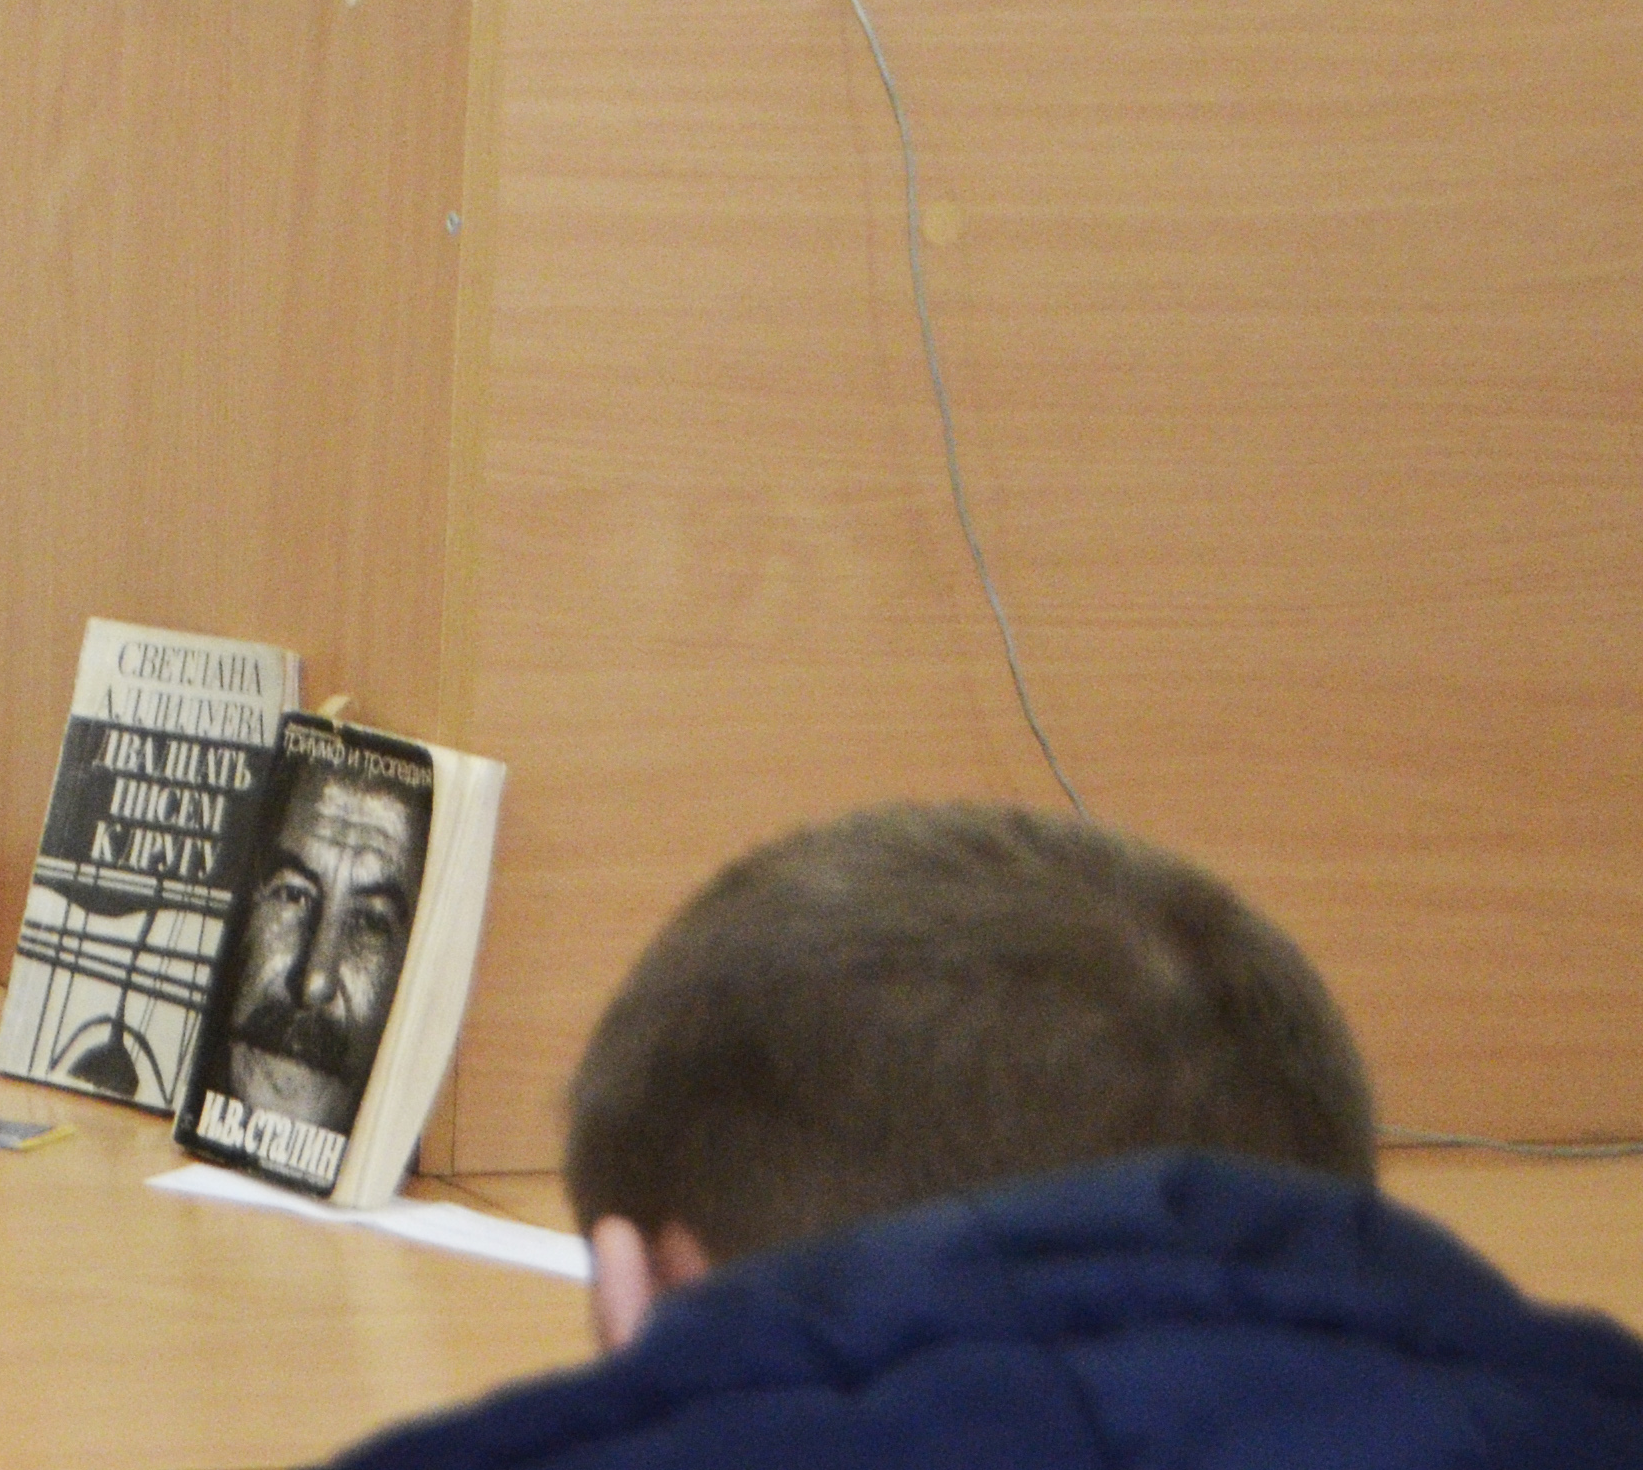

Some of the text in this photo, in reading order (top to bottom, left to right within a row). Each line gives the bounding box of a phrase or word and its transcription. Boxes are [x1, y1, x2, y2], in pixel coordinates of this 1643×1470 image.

[118, 639, 264, 697] СВЕТЛАНА
[110, 776, 225, 834] ПИСЕМ
[91, 820, 222, 880] К ДРУГУ
